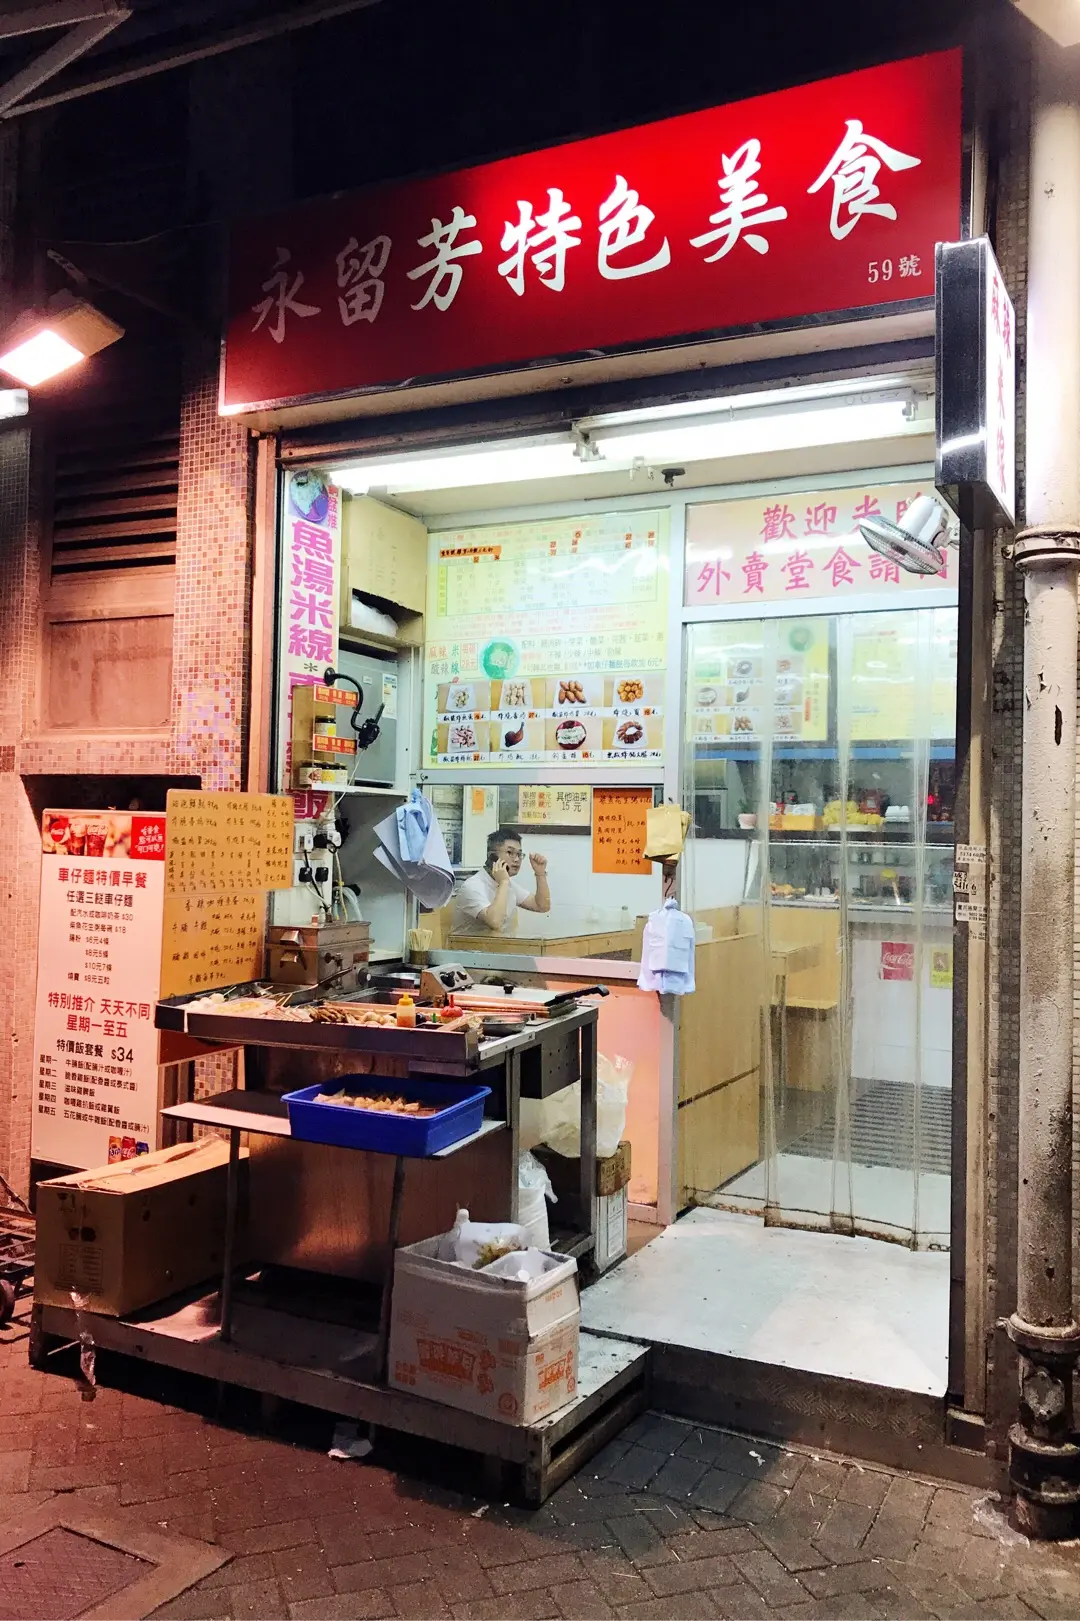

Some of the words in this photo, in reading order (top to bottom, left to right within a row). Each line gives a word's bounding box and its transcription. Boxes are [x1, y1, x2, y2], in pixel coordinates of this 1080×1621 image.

[251, 119, 921, 343] 永留芳特色美食
[868, 254, 921, 283] 59號
[759, 491, 923, 542] 歡迎光
[288, 520, 334, 664] 魚湯米線
[556, 791, 588, 802] 其他油菜
[561, 802, 570, 811] 15
[58, 868, 147, 888] 車仔麵特價早餐
[48, 992, 96, 1013] 特別推介
[100, 998, 151, 1021] 天天不同
[66, 1014, 128, 1039] 星期一至五
[56, 1038, 104, 1058] 特價飯套餐
[40, 1054, 58, 1064] 星期一
[39, 1066, 57, 1077] 星期二
[39, 1079, 57, 1090] 星期三
[38, 1092, 57, 1103] 星期四
[38, 1104, 56, 1116] 星期五
